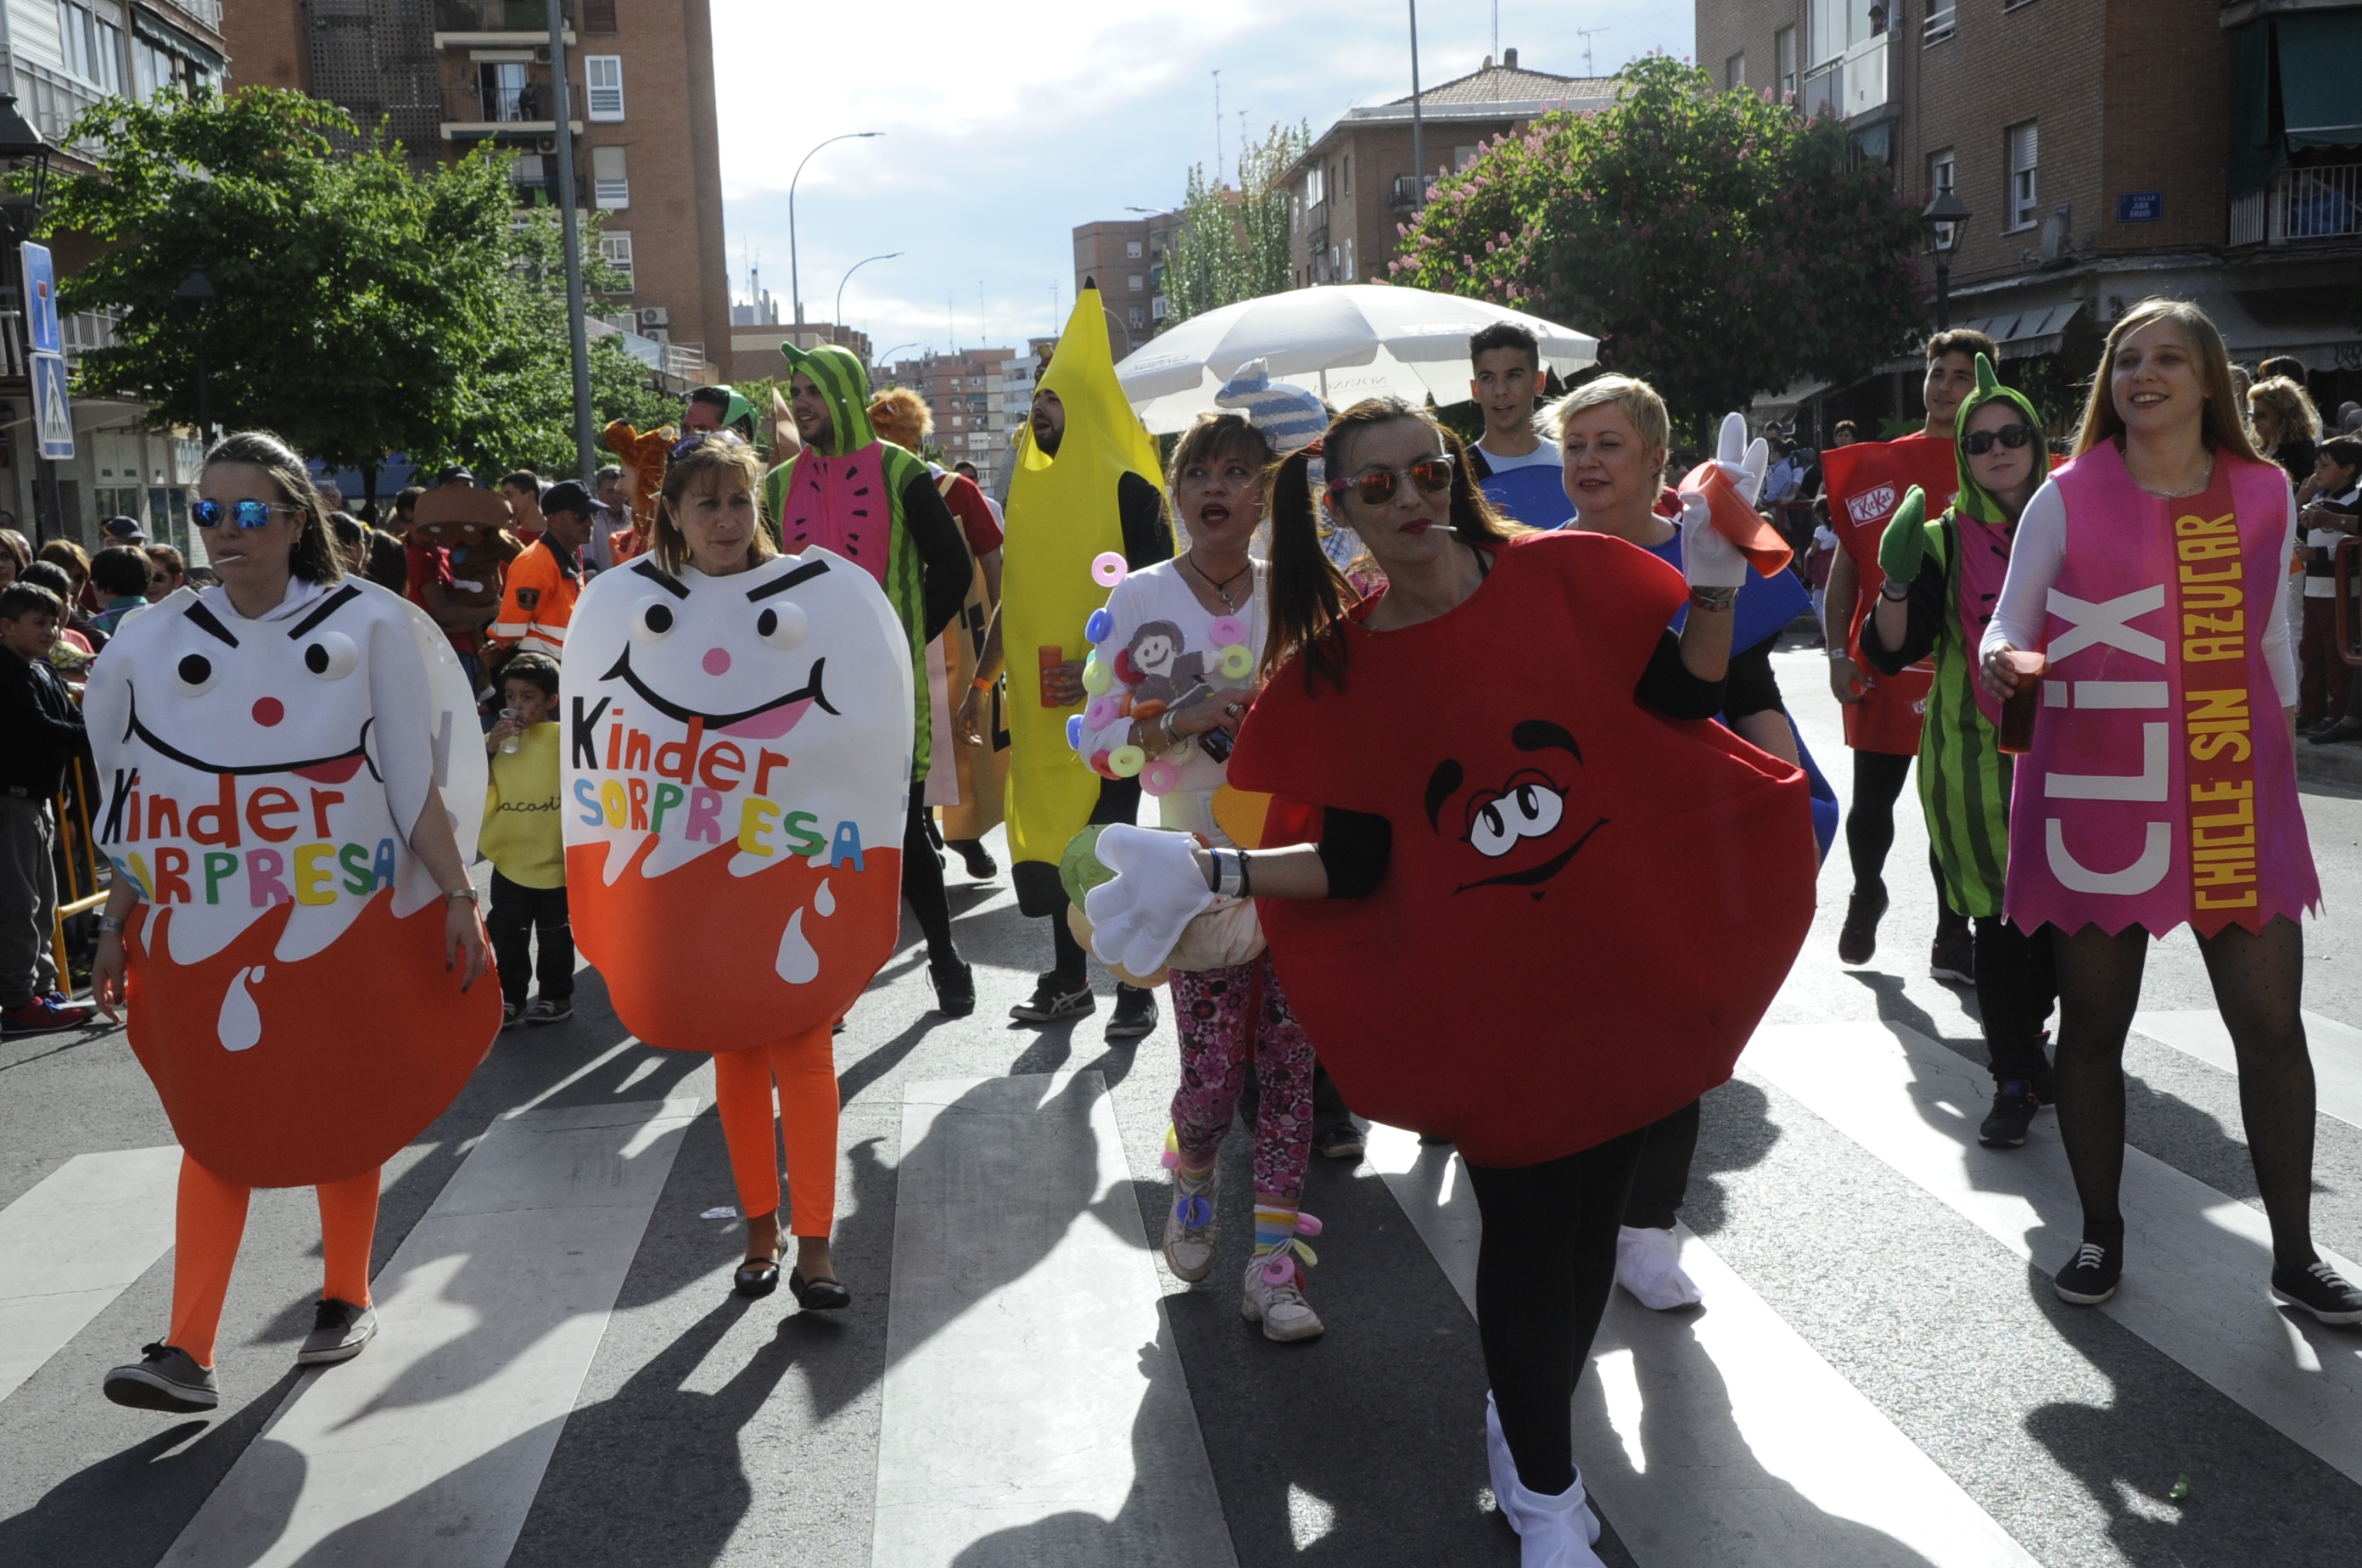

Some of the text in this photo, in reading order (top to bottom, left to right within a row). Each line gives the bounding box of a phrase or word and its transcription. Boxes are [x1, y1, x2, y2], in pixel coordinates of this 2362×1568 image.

[2130, 210, 2151, 218] BRAVO
[1858, 490, 1892, 518] KitKat
[572, 697, 789, 796] Kinder
[2175, 512, 2258, 910] CHICLE SIN AZUCAR
[100, 767, 344, 849] Kinder
[574, 778, 865, 872] SORPRESA
